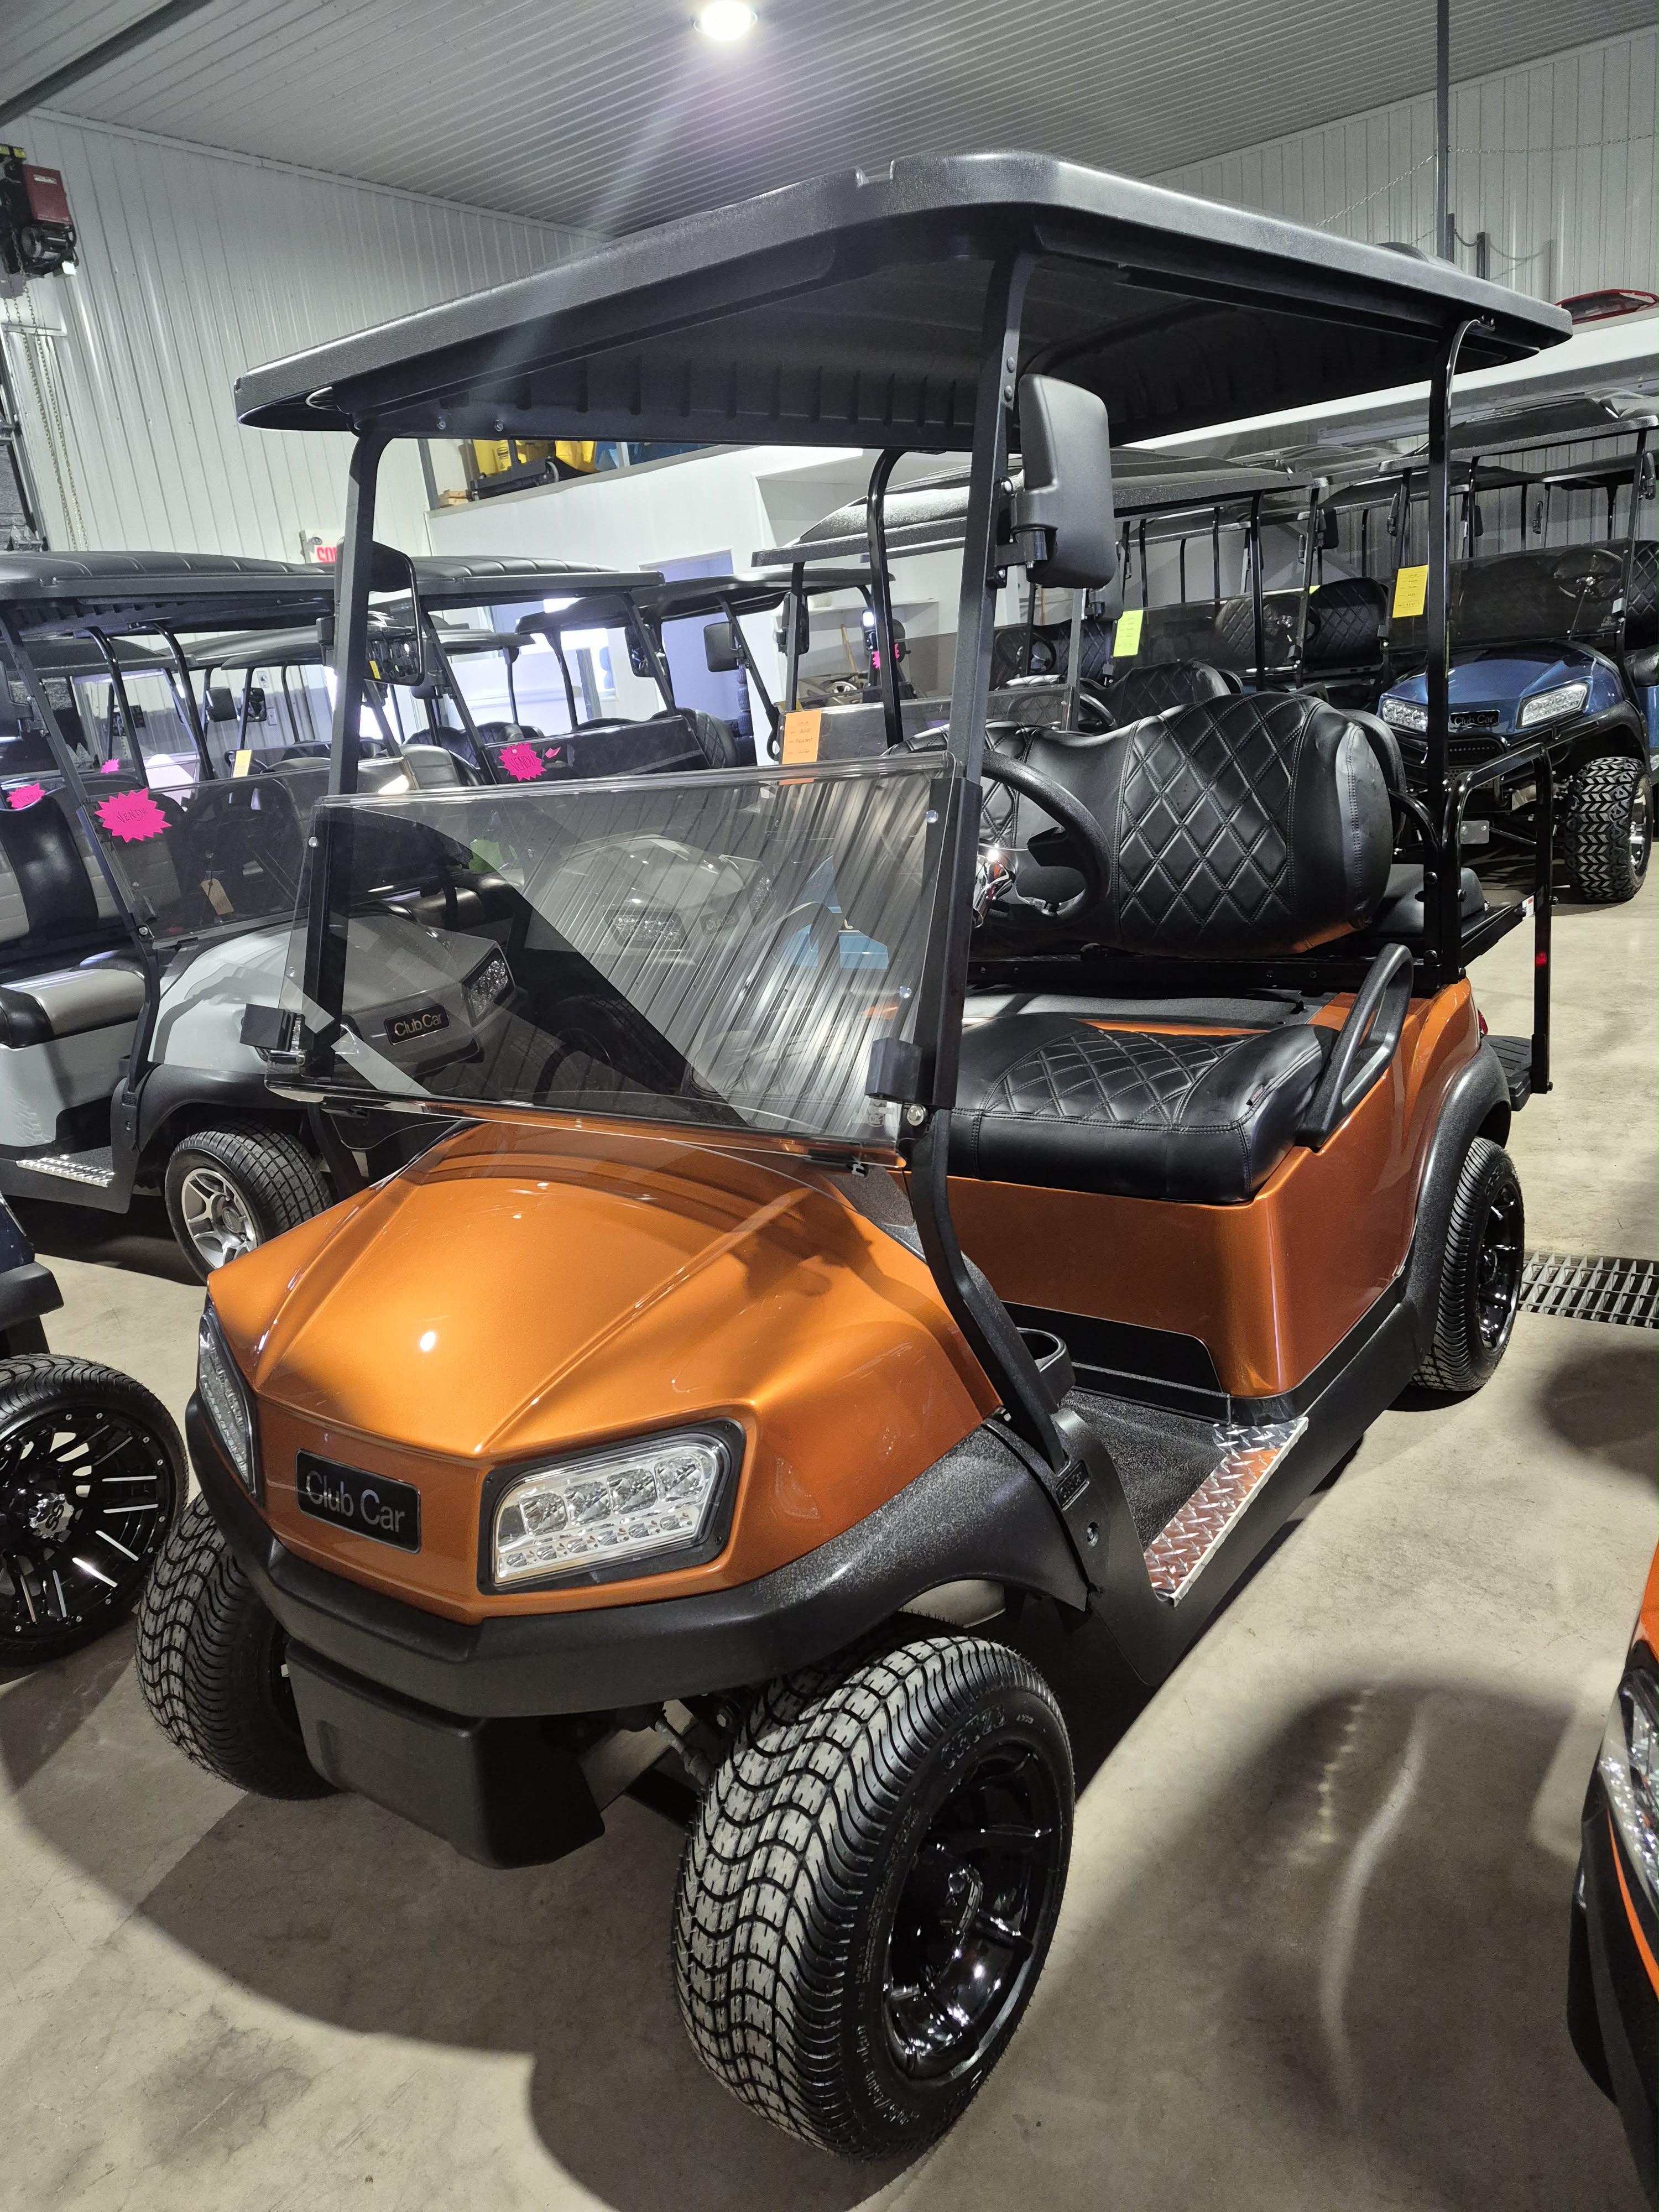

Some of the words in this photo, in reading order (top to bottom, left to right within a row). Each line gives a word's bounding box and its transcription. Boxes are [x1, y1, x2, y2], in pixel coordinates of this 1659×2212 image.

[1477, 714, 1495, 724] Car
[509, 754, 536, 771] VENDU
[394, 1018, 422, 1036] Club
[422, 1014, 442, 1027] Car
[306, 1470, 354, 1517] Club
[360, 1489, 405, 1532] Car
